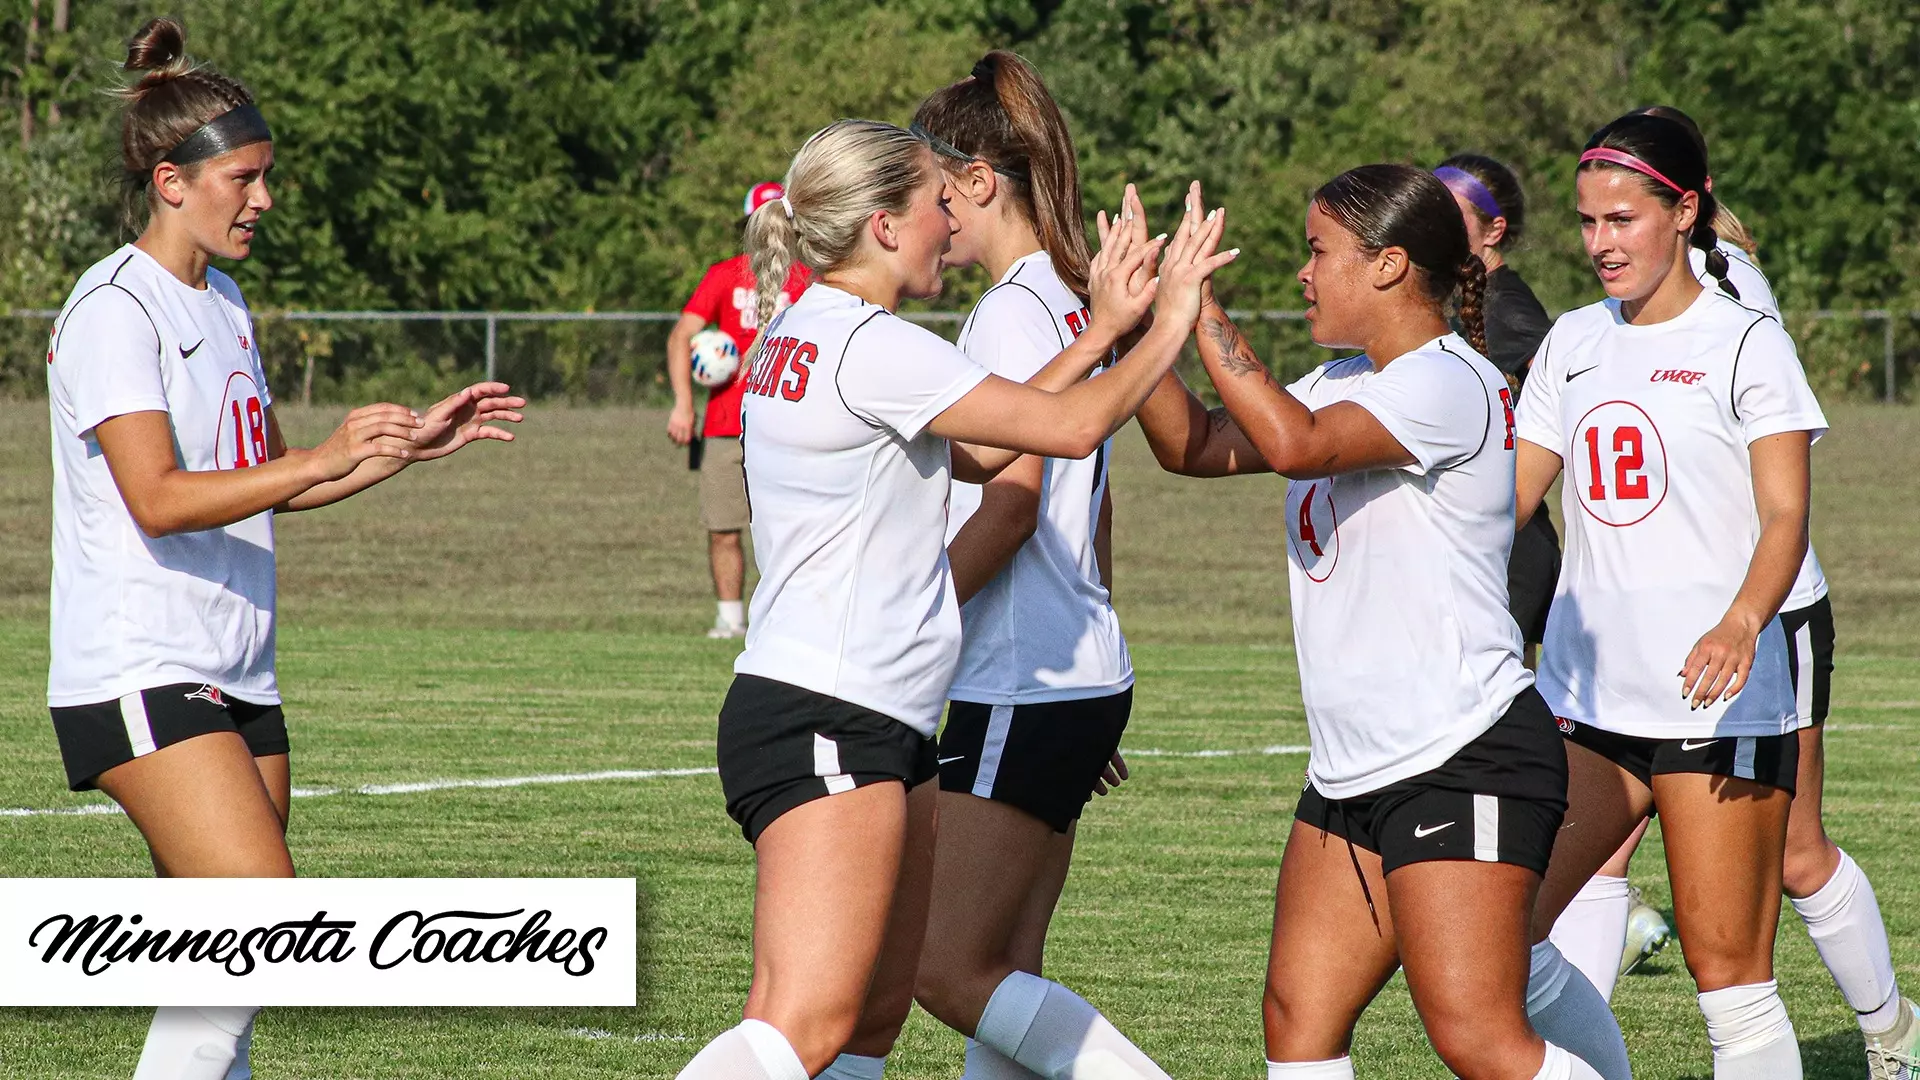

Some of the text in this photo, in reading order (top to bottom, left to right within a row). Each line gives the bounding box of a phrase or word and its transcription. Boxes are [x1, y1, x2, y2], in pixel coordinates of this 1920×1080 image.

[1650, 369, 1706, 385] UWRF
[231, 396, 267, 468] 18
[1585, 426, 1649, 500] 12
[1300, 483, 1324, 557] 4
